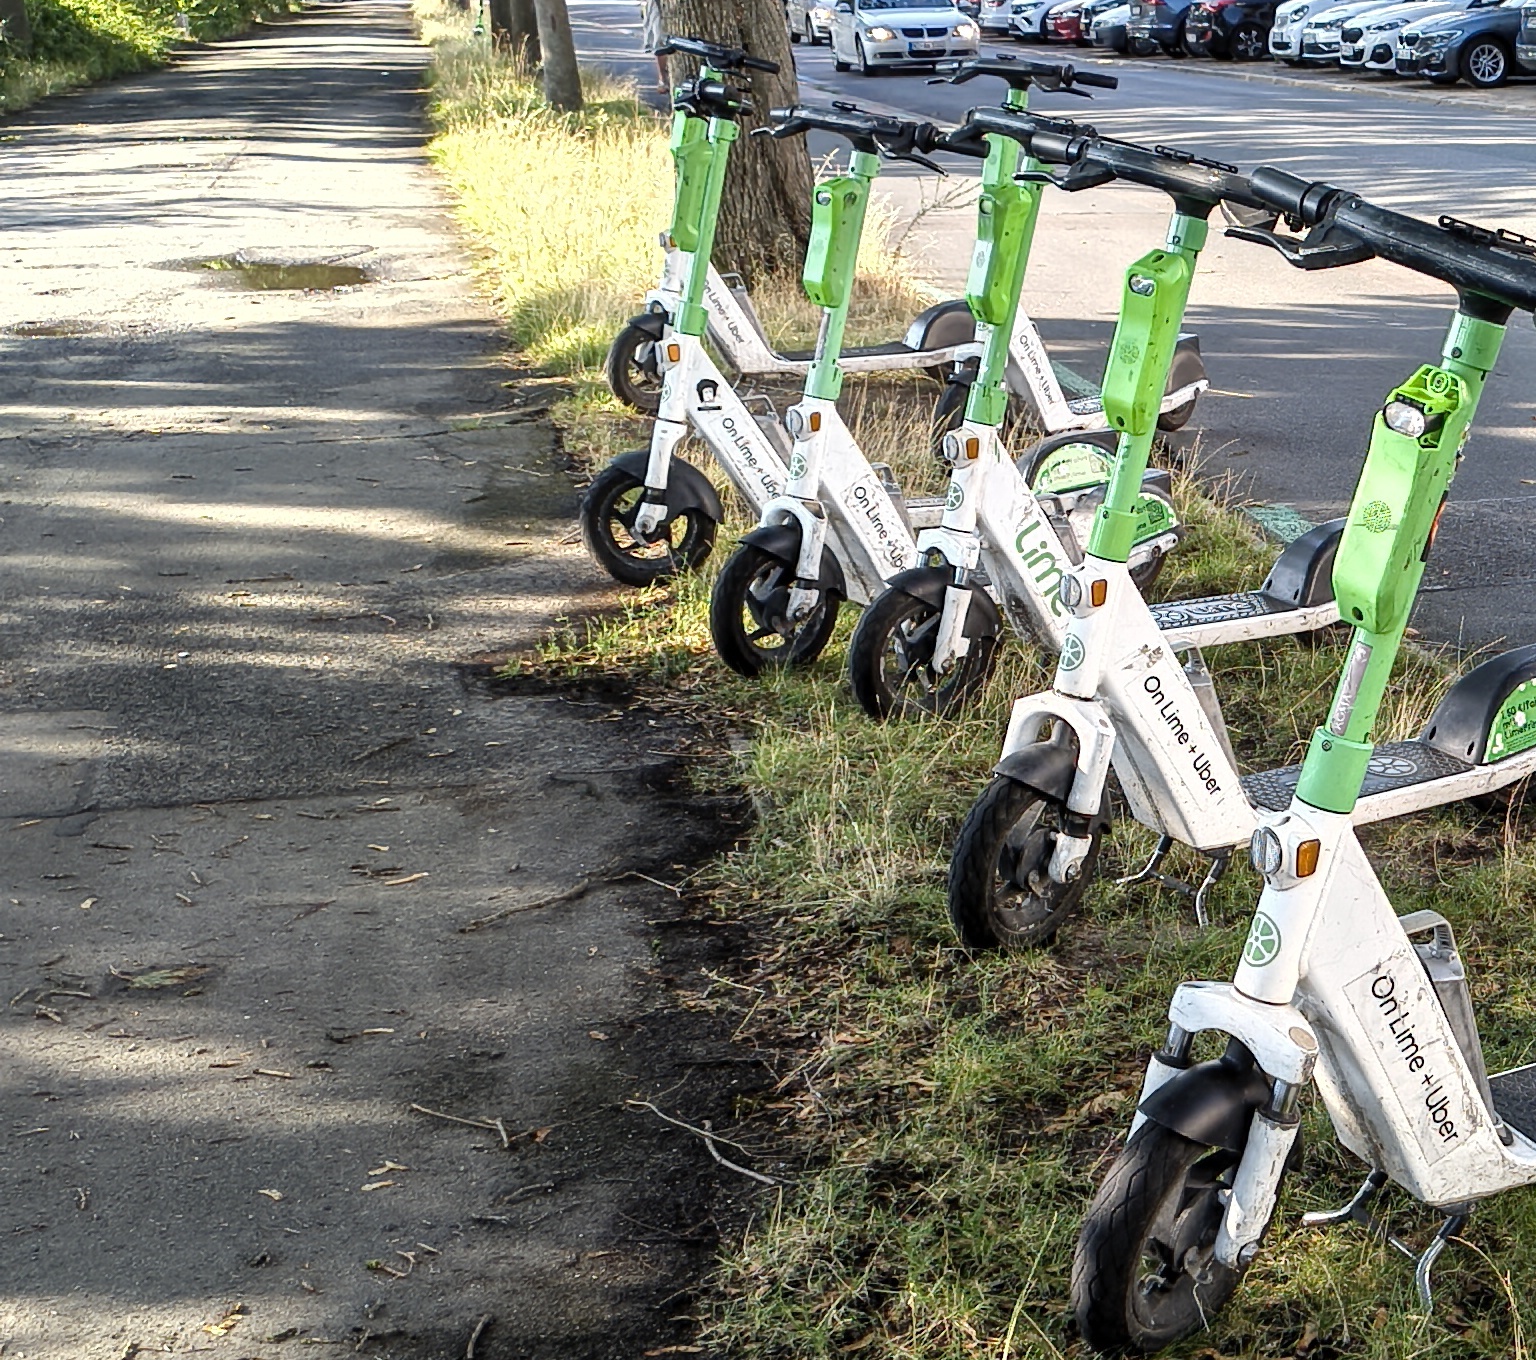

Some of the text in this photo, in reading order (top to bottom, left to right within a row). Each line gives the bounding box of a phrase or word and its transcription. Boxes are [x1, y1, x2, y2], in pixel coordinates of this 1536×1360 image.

[722, 417, 738, 437] On
[734, 435, 757, 467] Lime
[761, 474, 781, 499] Ube
[854, 486, 870, 509] On
[866, 504, 888, 540] Lime
[1144, 675, 1165, 706] On
[1160, 700, 1189, 745] Lime
[1193, 752, 1222, 796] Uber
[1371, 975, 1398, 1016] On
[1389, 1012, 1425, 1073] Lime
[1425, 1085, 1459, 1143] Uber
